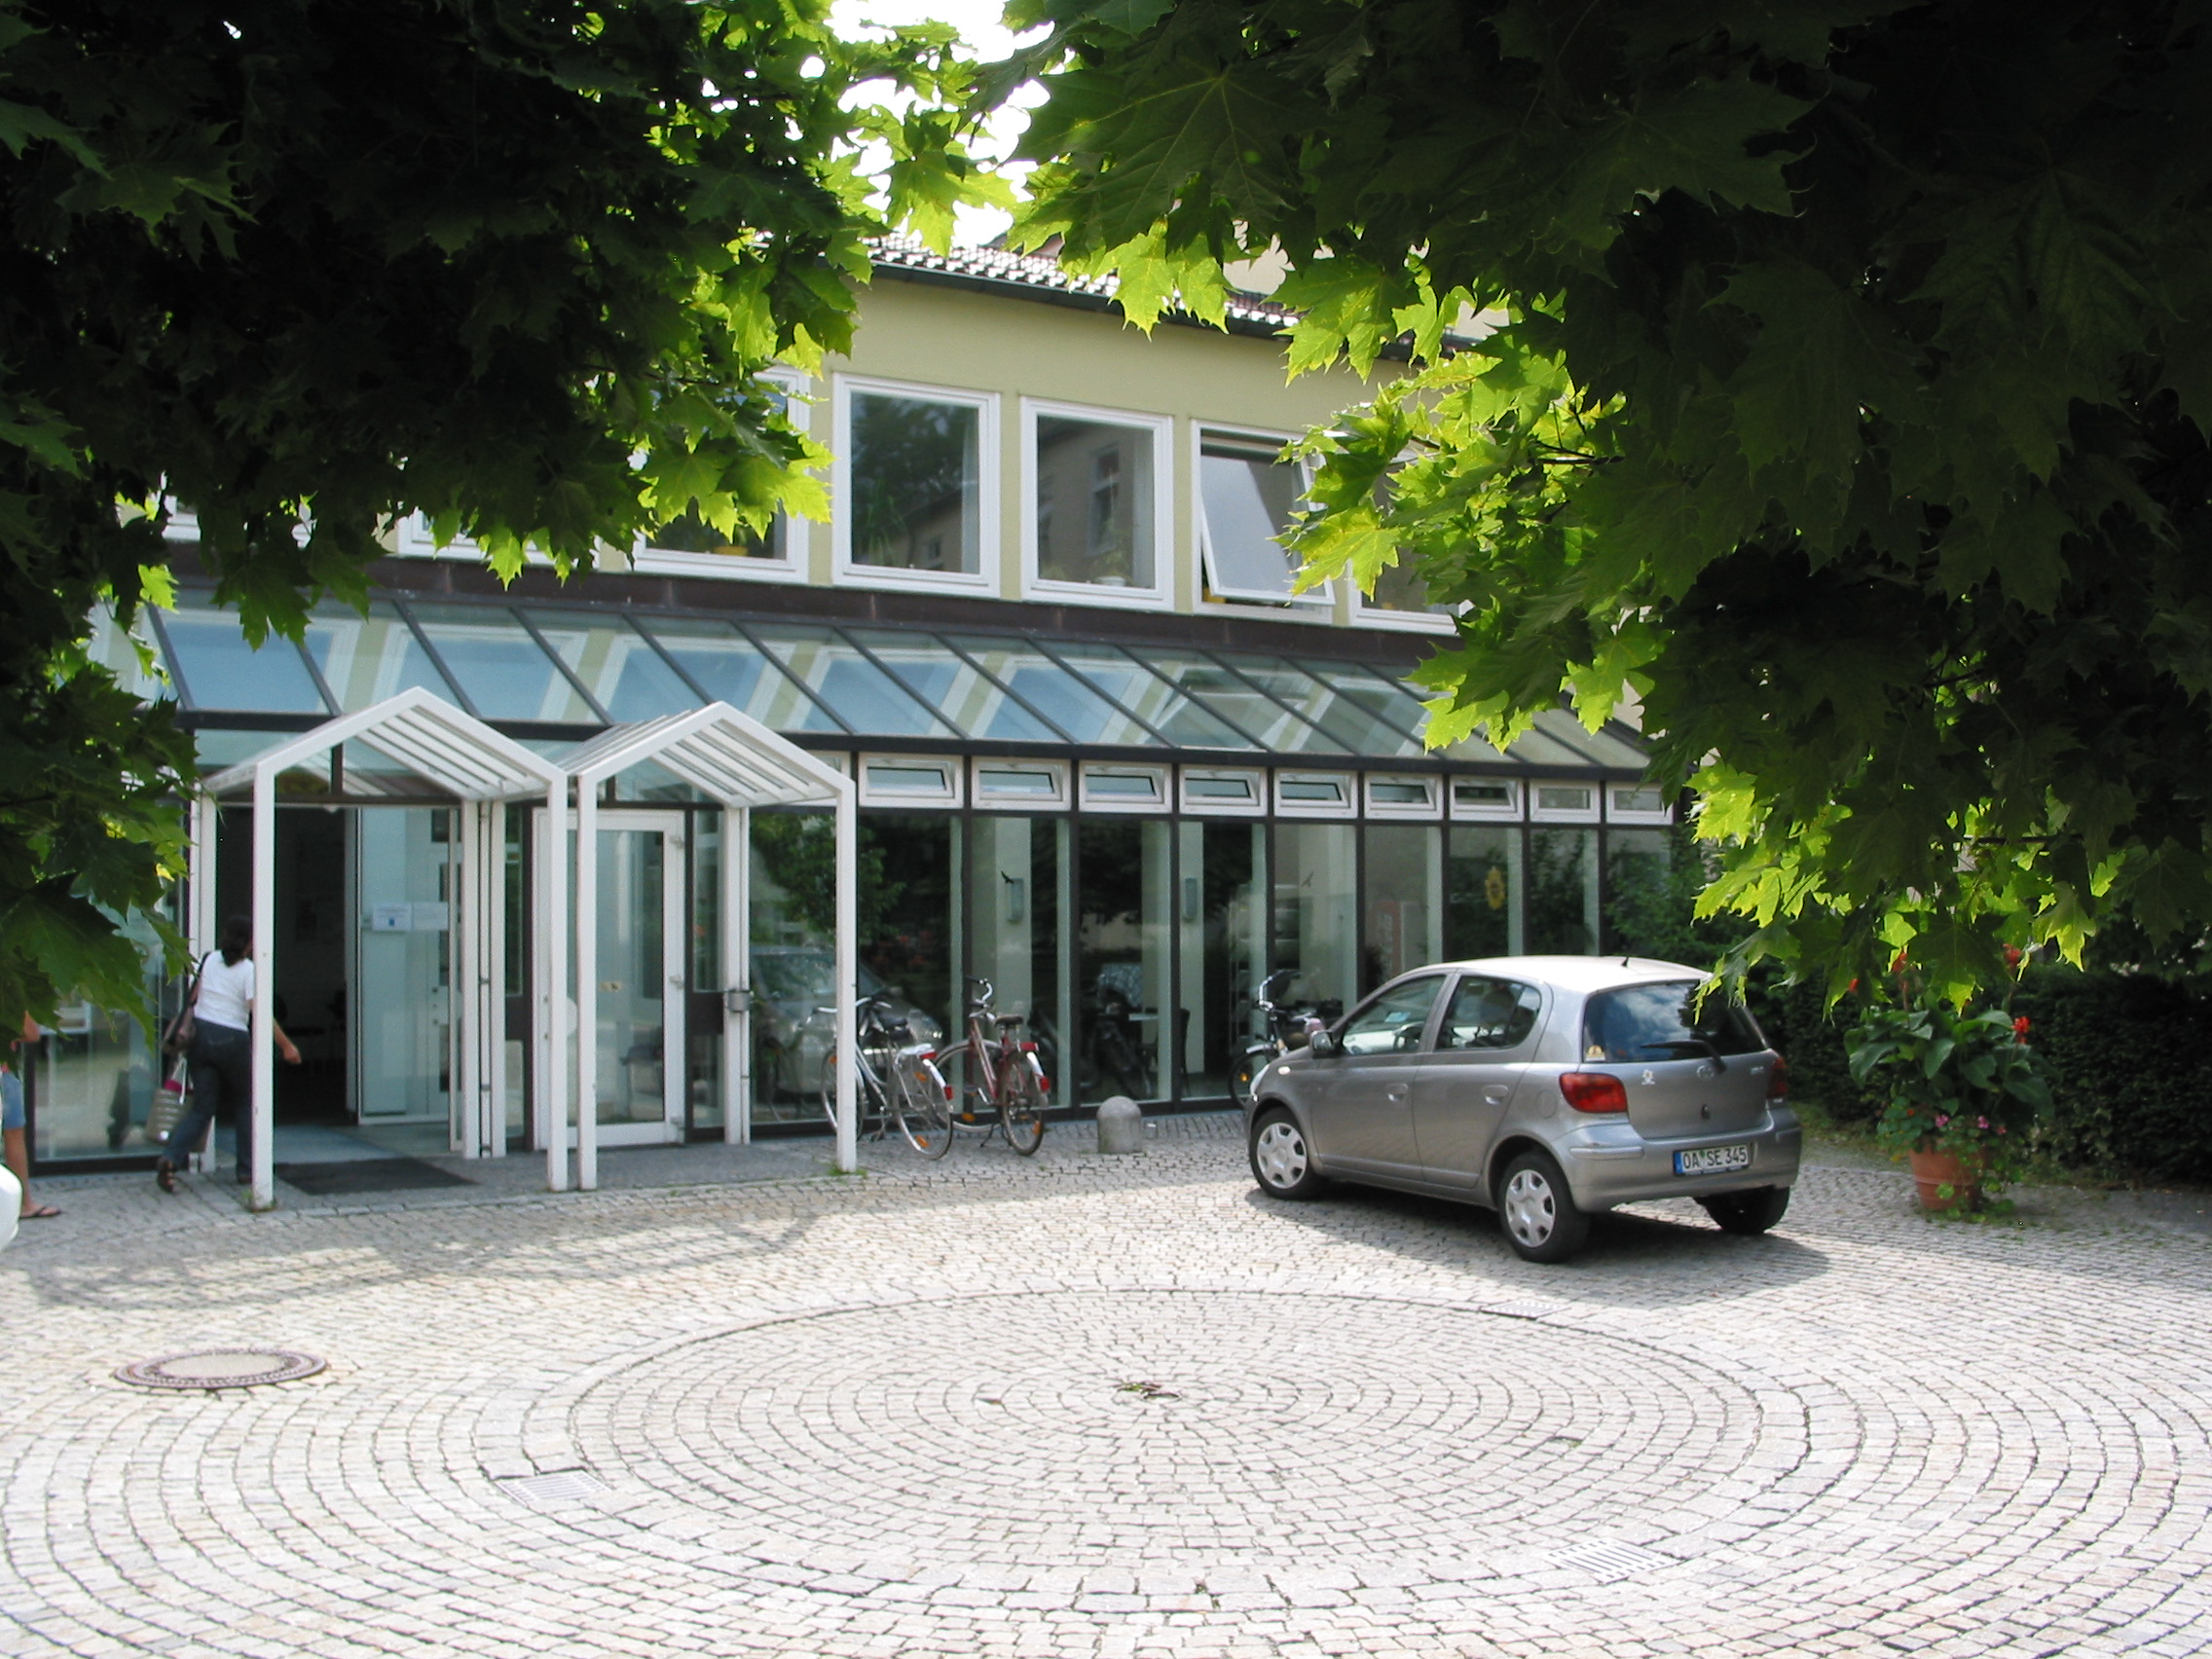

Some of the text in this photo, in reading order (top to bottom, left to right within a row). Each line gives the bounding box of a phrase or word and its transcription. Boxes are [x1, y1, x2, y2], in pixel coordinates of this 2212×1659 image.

[1682, 1147, 1748, 1169] OA SE 345
